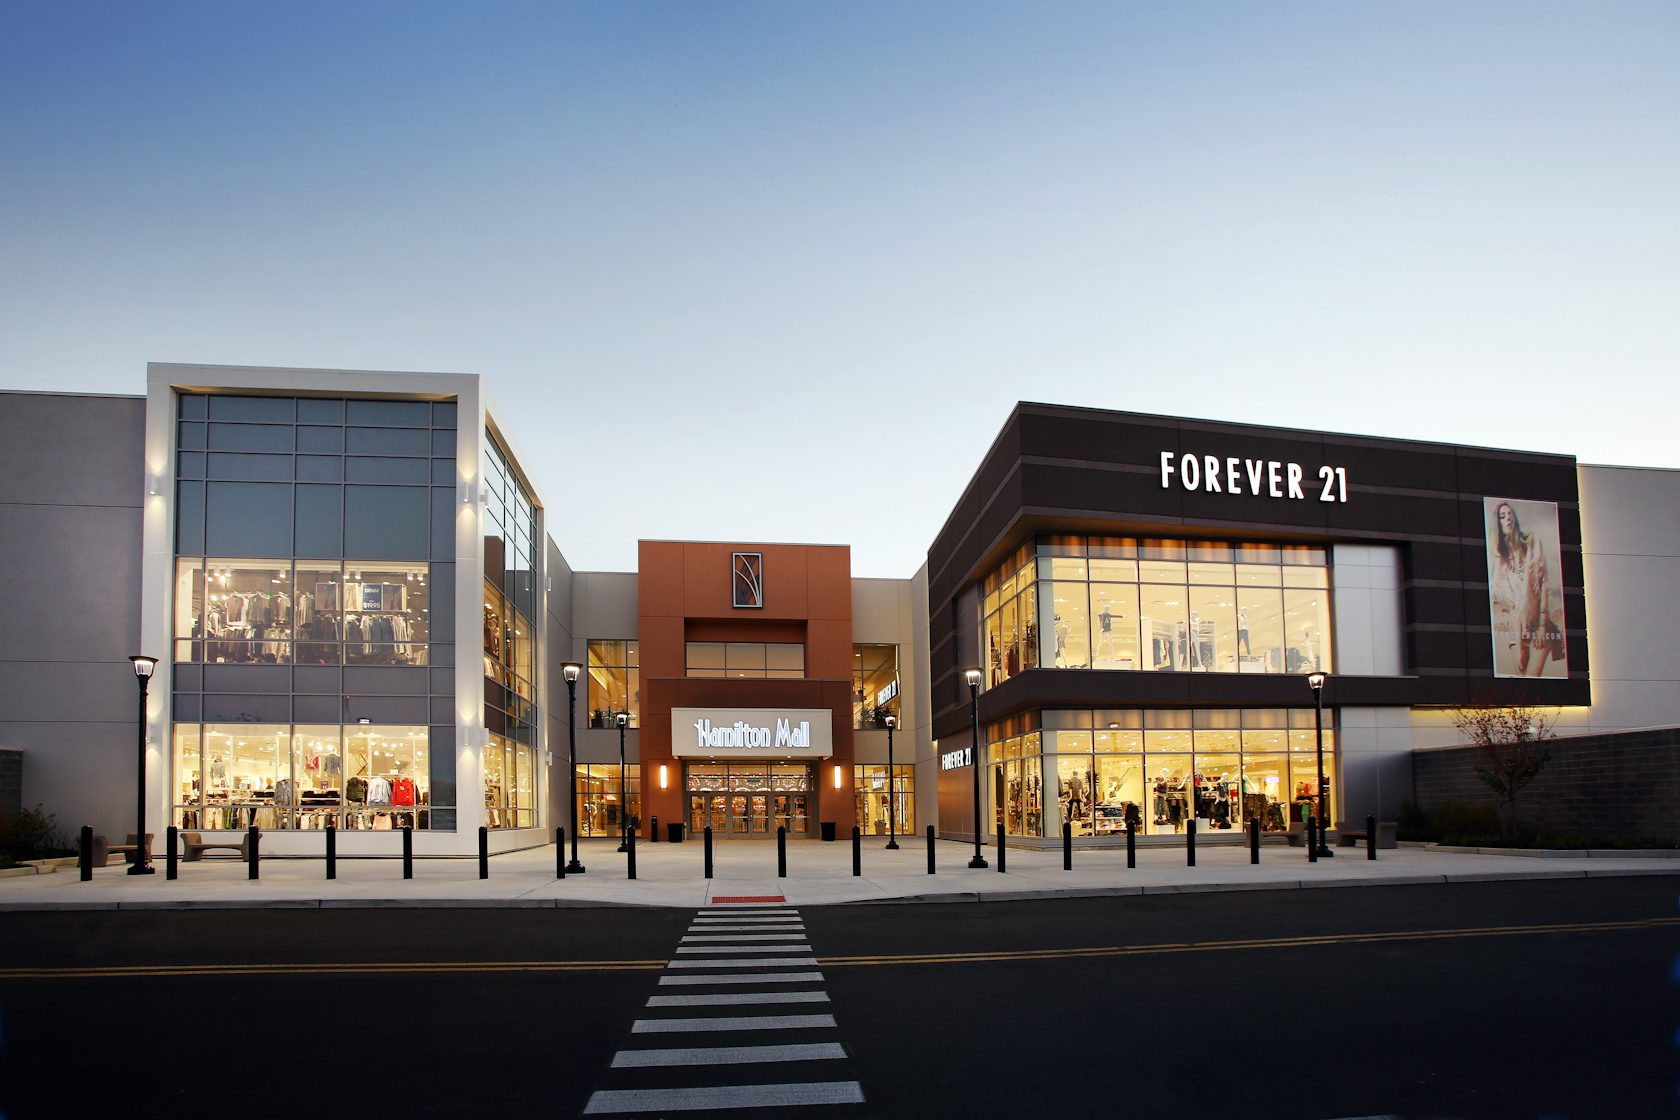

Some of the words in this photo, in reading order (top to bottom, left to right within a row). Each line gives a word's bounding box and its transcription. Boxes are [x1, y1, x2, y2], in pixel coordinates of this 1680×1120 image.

[1160, 451, 1305, 500] FOREVER
[1319, 465, 1347, 503] 21
[694, 719, 771, 748] Hamilton
[775, 718, 809, 748] Mall
[942, 749, 964, 770] FOREVER
[965, 747, 971, 766] 21
